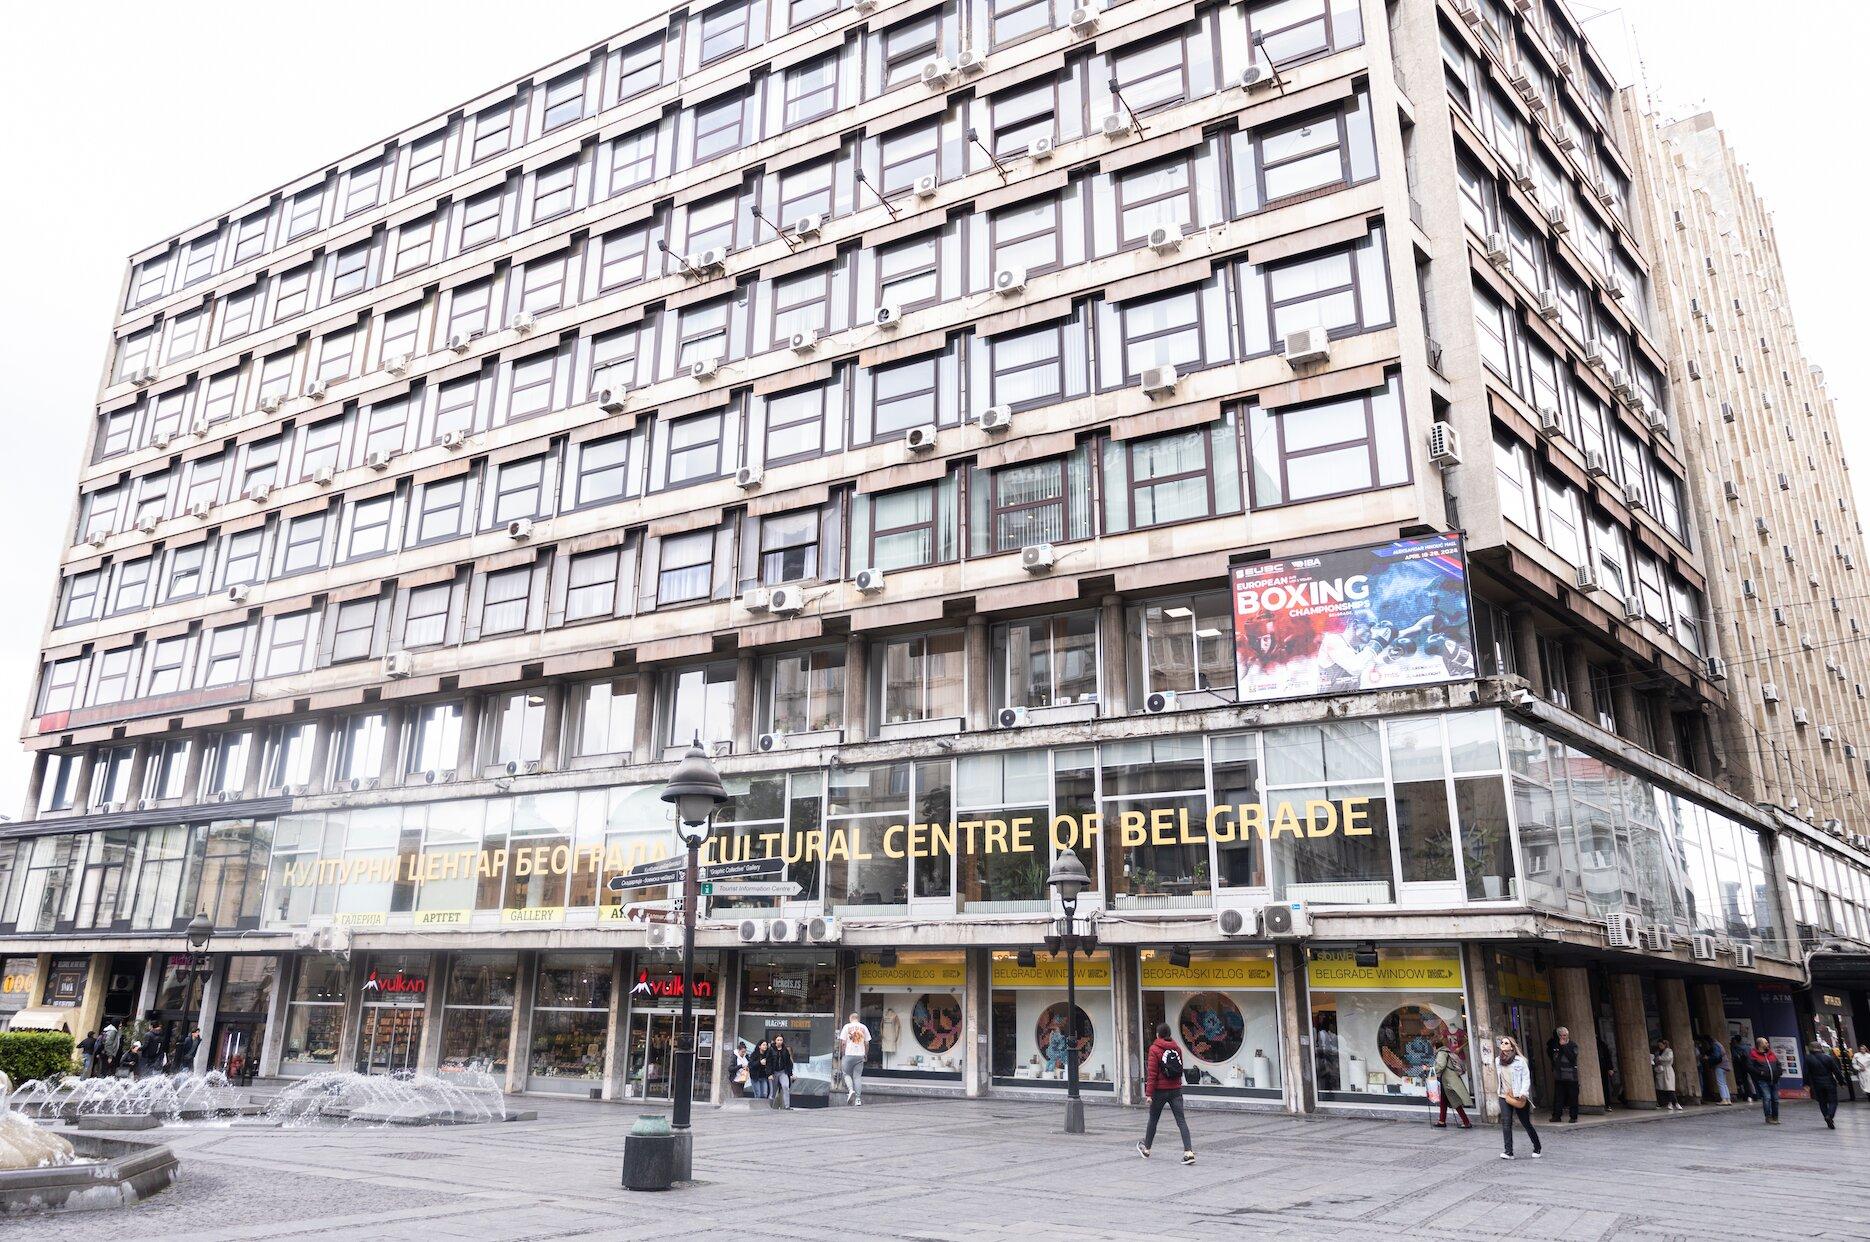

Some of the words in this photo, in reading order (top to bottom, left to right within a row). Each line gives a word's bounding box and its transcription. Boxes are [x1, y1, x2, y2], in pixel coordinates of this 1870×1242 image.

[1245, 563, 1284, 576] EUBC
[1237, 576, 1288, 591] EUROPEAN
[1237, 574, 1370, 615] BOXING
[1289, 599, 1371, 618] CHAMPIONSHIPS
[699, 828, 872, 866] CULTURAL
[882, 816, 1034, 859] CENTRE
[1053, 813, 1104, 850] OF
[1119, 796, 1373, 847] BELGRADE
[283, 854, 402, 887] КУЛТУРНИ
[408, 848, 509, 888] ЦЕНТАР
[515, 839, 671, 877] БЕОГРАДА
[746, 864, 761, 872] Gallery
[340, 914, 381, 925] ГАЛЕРИЈА
[422, 912, 462, 923] АРТГЕТ
[510, 909, 554, 921] GALLERY
[861, 969, 911, 979] BEOGRADSKI
[912, 969, 935, 979] IZLOG
[994, 968, 1042, 979] BELGRADE
[1143, 968, 1210, 979] BEOGRADSKI
[1212, 968, 1244, 979] IZLOG
[1315, 968, 1374, 979] BELGRADE
[1376, 968, 1426, 979] WINDOW
[378, 971, 425, 993] vulkan
[1772, 993, 1792, 1001] ATM
